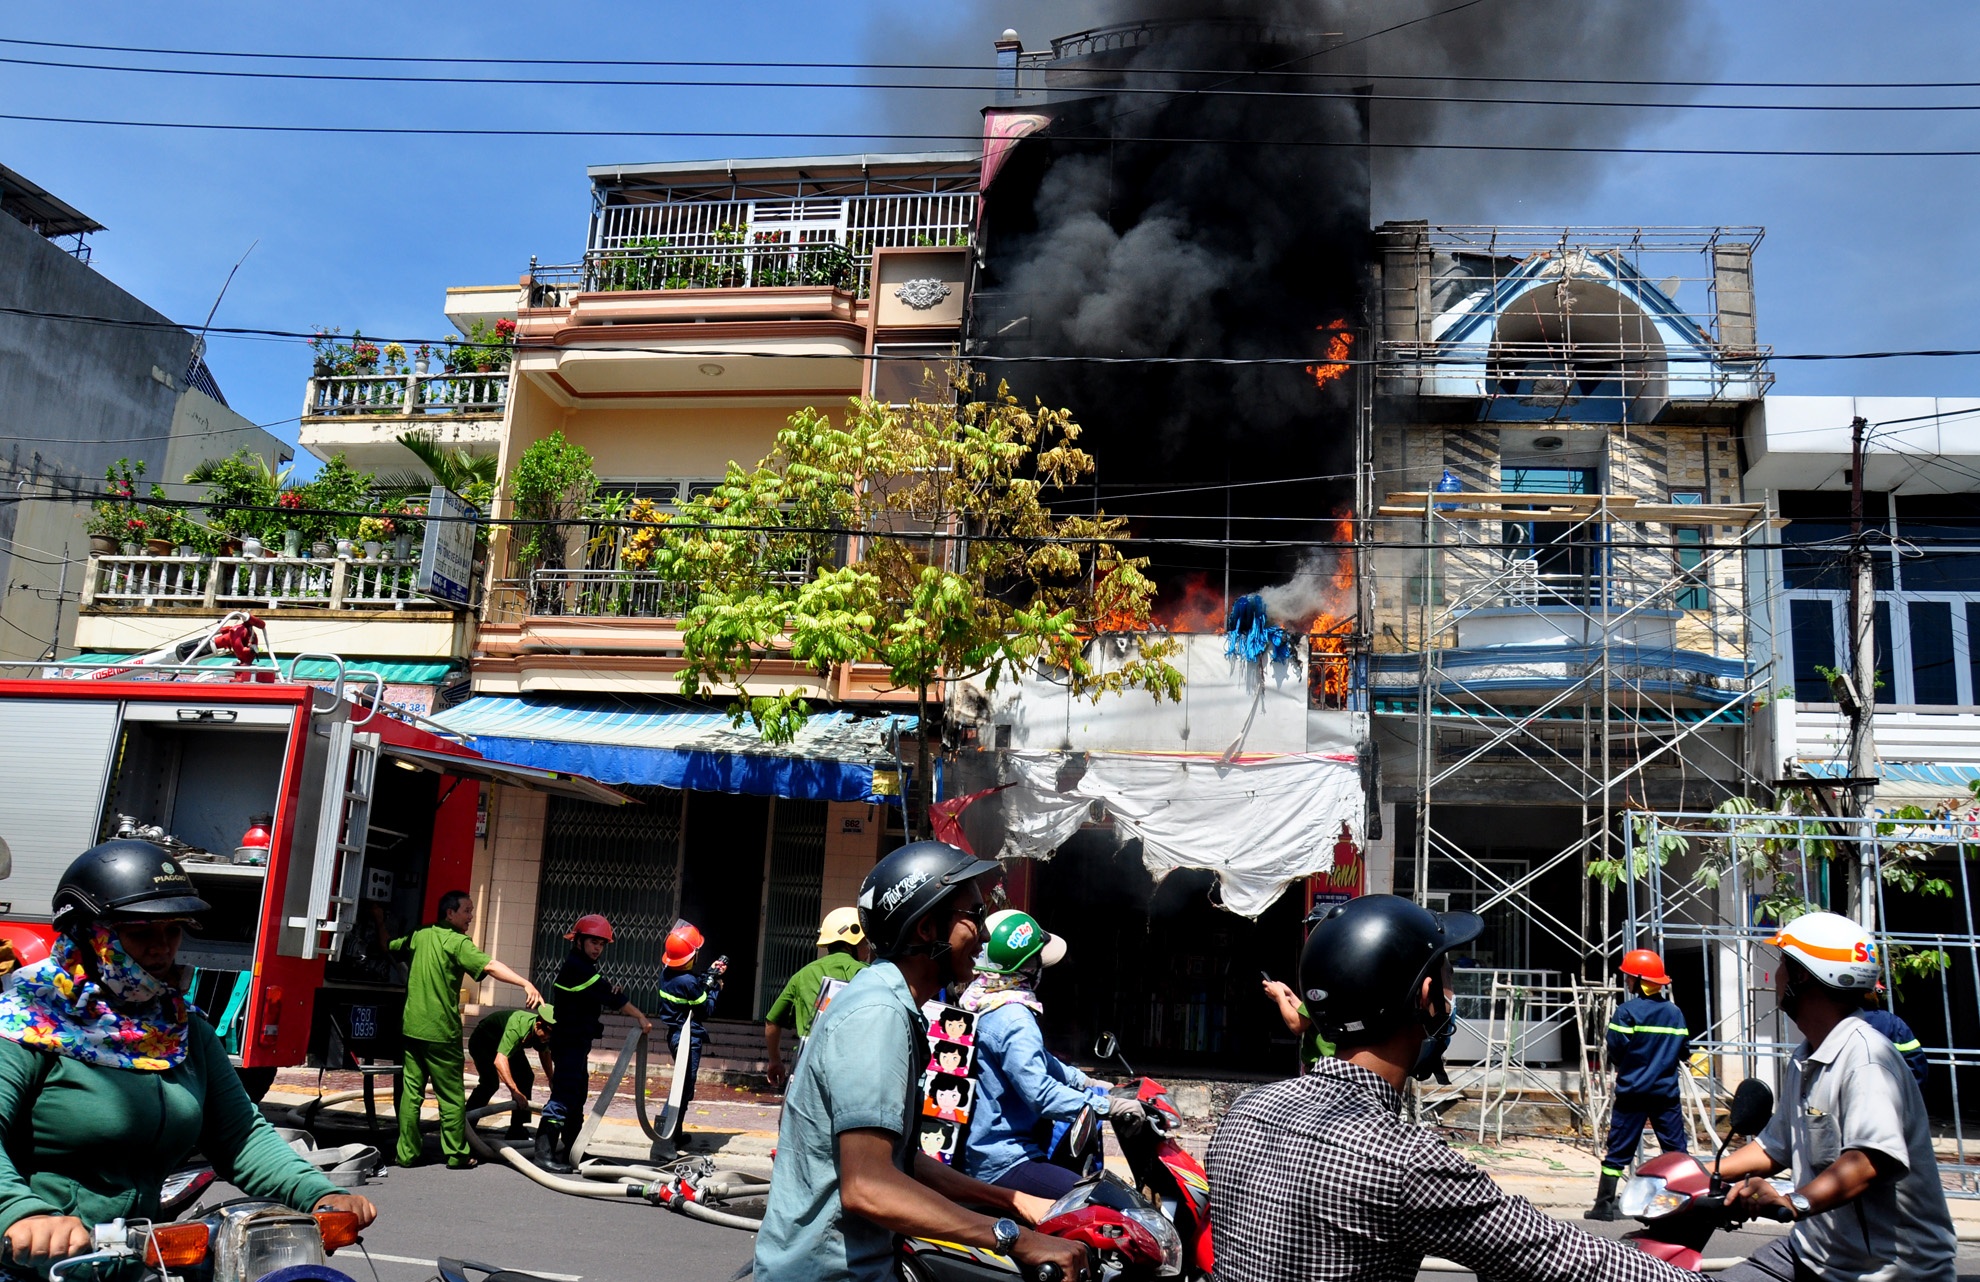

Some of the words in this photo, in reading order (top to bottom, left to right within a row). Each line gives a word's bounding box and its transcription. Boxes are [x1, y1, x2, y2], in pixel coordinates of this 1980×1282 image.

[844, 820, 860, 828] 662
[153, 874, 186, 883] PIAGGIO
[354, 1022, 374, 1037] 0935
